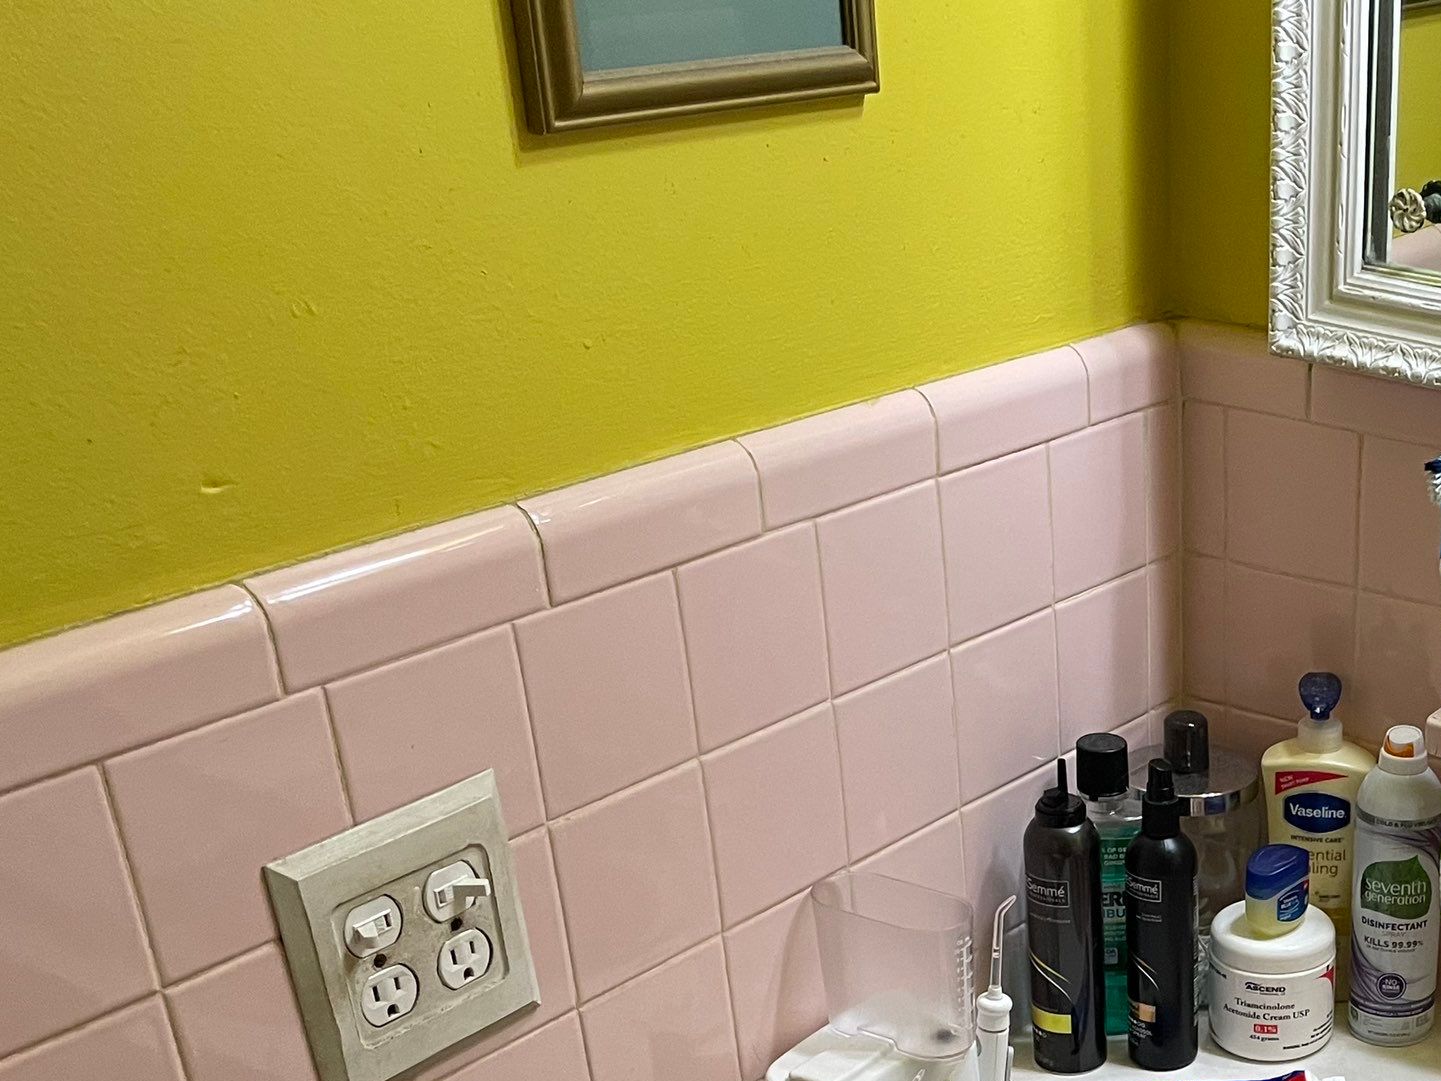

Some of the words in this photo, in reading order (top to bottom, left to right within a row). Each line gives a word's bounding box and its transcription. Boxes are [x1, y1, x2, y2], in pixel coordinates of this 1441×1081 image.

[1289, 803, 1345, 818] Vaseline
[1309, 849, 1346, 861] ential
[1312, 862, 1338, 877] ling
[1365, 878, 1426, 895] seventh
[1365, 891, 1425, 905] generation
[1361, 916, 1428, 931] DISINFECTANT
[1364, 935, 1389, 948] KILLS
[1391, 940, 1423, 949] 99.99%
[1245, 983, 1286, 993] ASCEND
[1235, 997, 1295, 1010] Triamcinolone
[1223, 1003, 1261, 1020] Acetonide
[1262, 1012, 1291, 1021] Cream
[1292, 1009, 1310, 1019] USP
[1254, 1025, 1277, 1034] 0.1%
